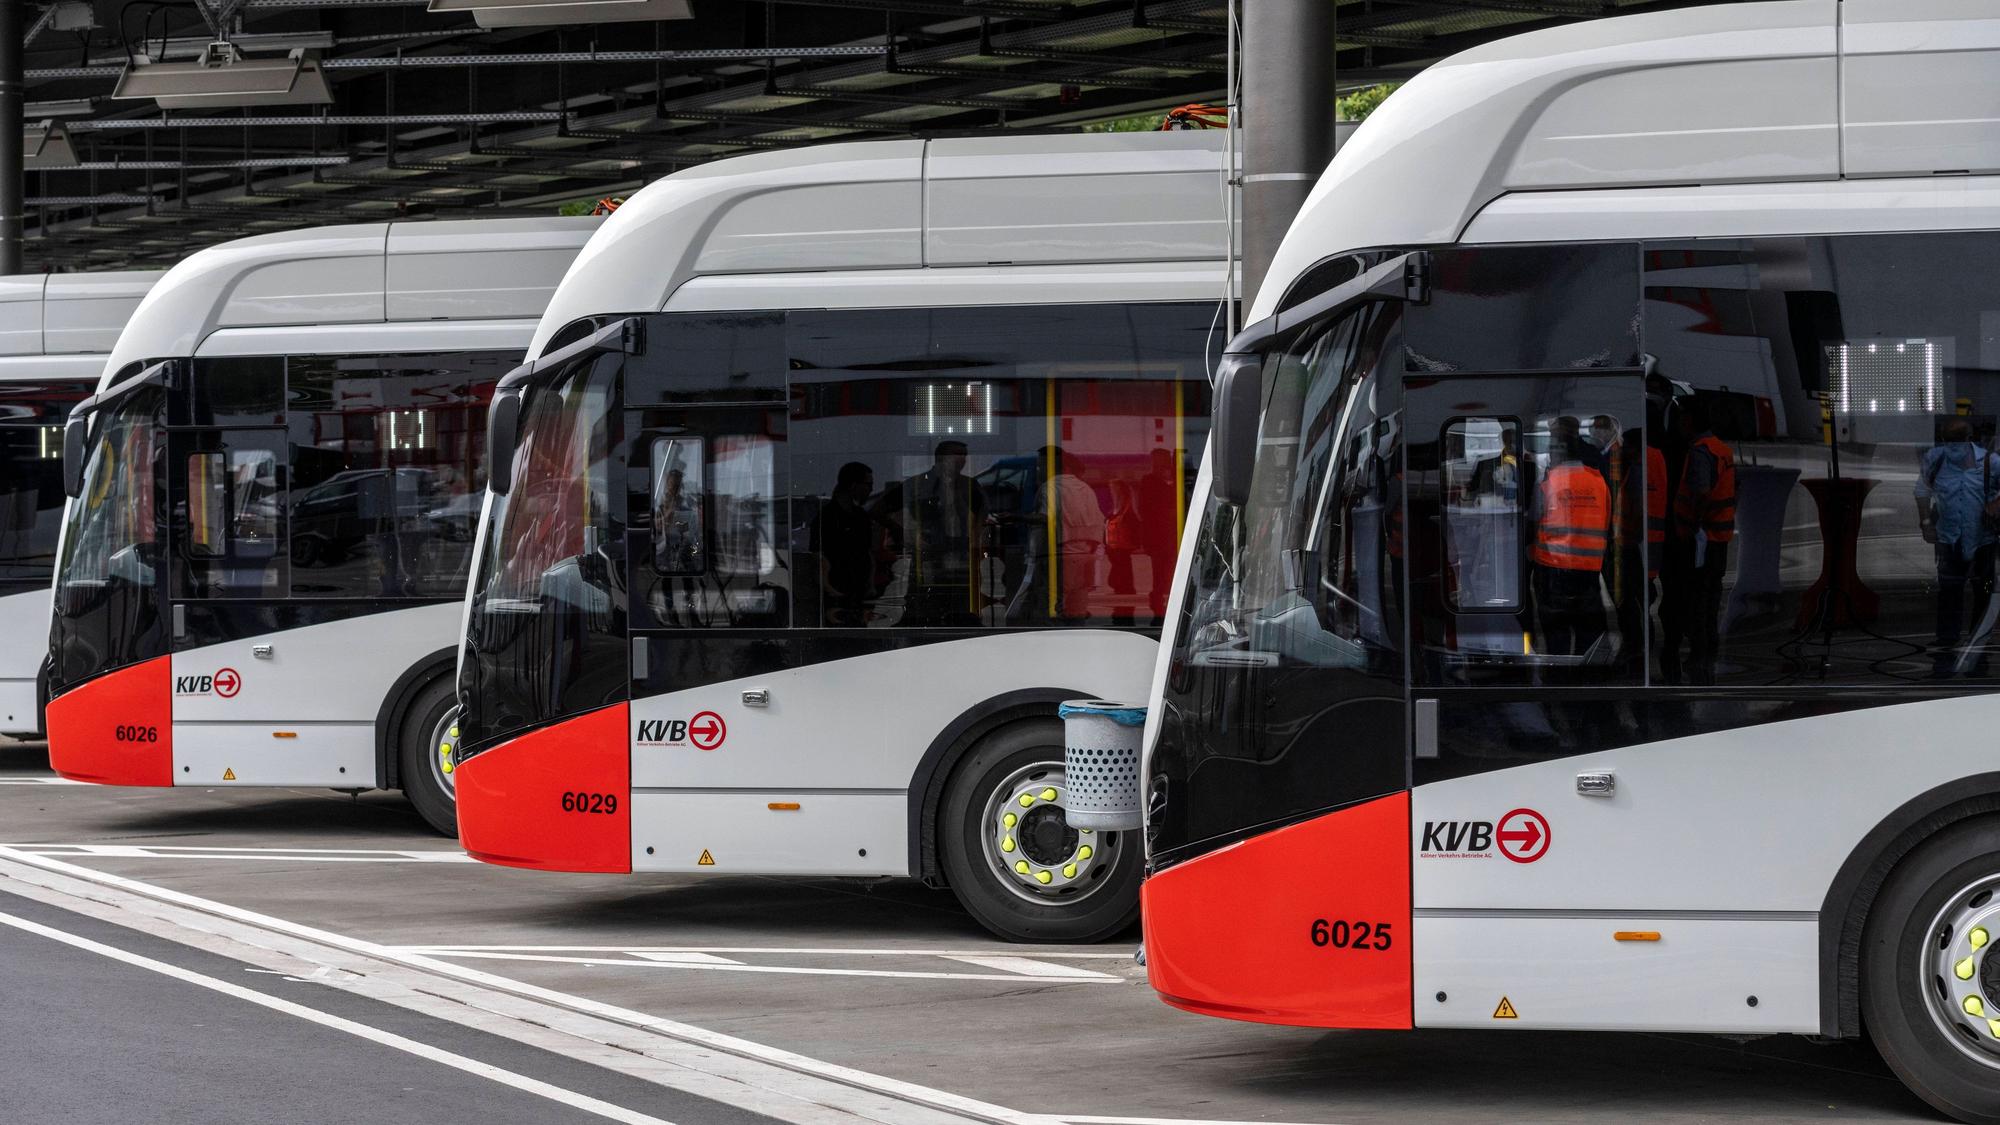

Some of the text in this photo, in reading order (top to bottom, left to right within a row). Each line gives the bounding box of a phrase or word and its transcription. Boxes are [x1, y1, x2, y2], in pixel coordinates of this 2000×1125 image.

[176, 676, 212, 693] KVB
[116, 725, 157, 742] 6026
[637, 720, 687, 741] KVB
[562, 791, 617, 814] 6029
[1421, 822, 1493, 851] KVB
[1311, 919, 1392, 950] 6025
